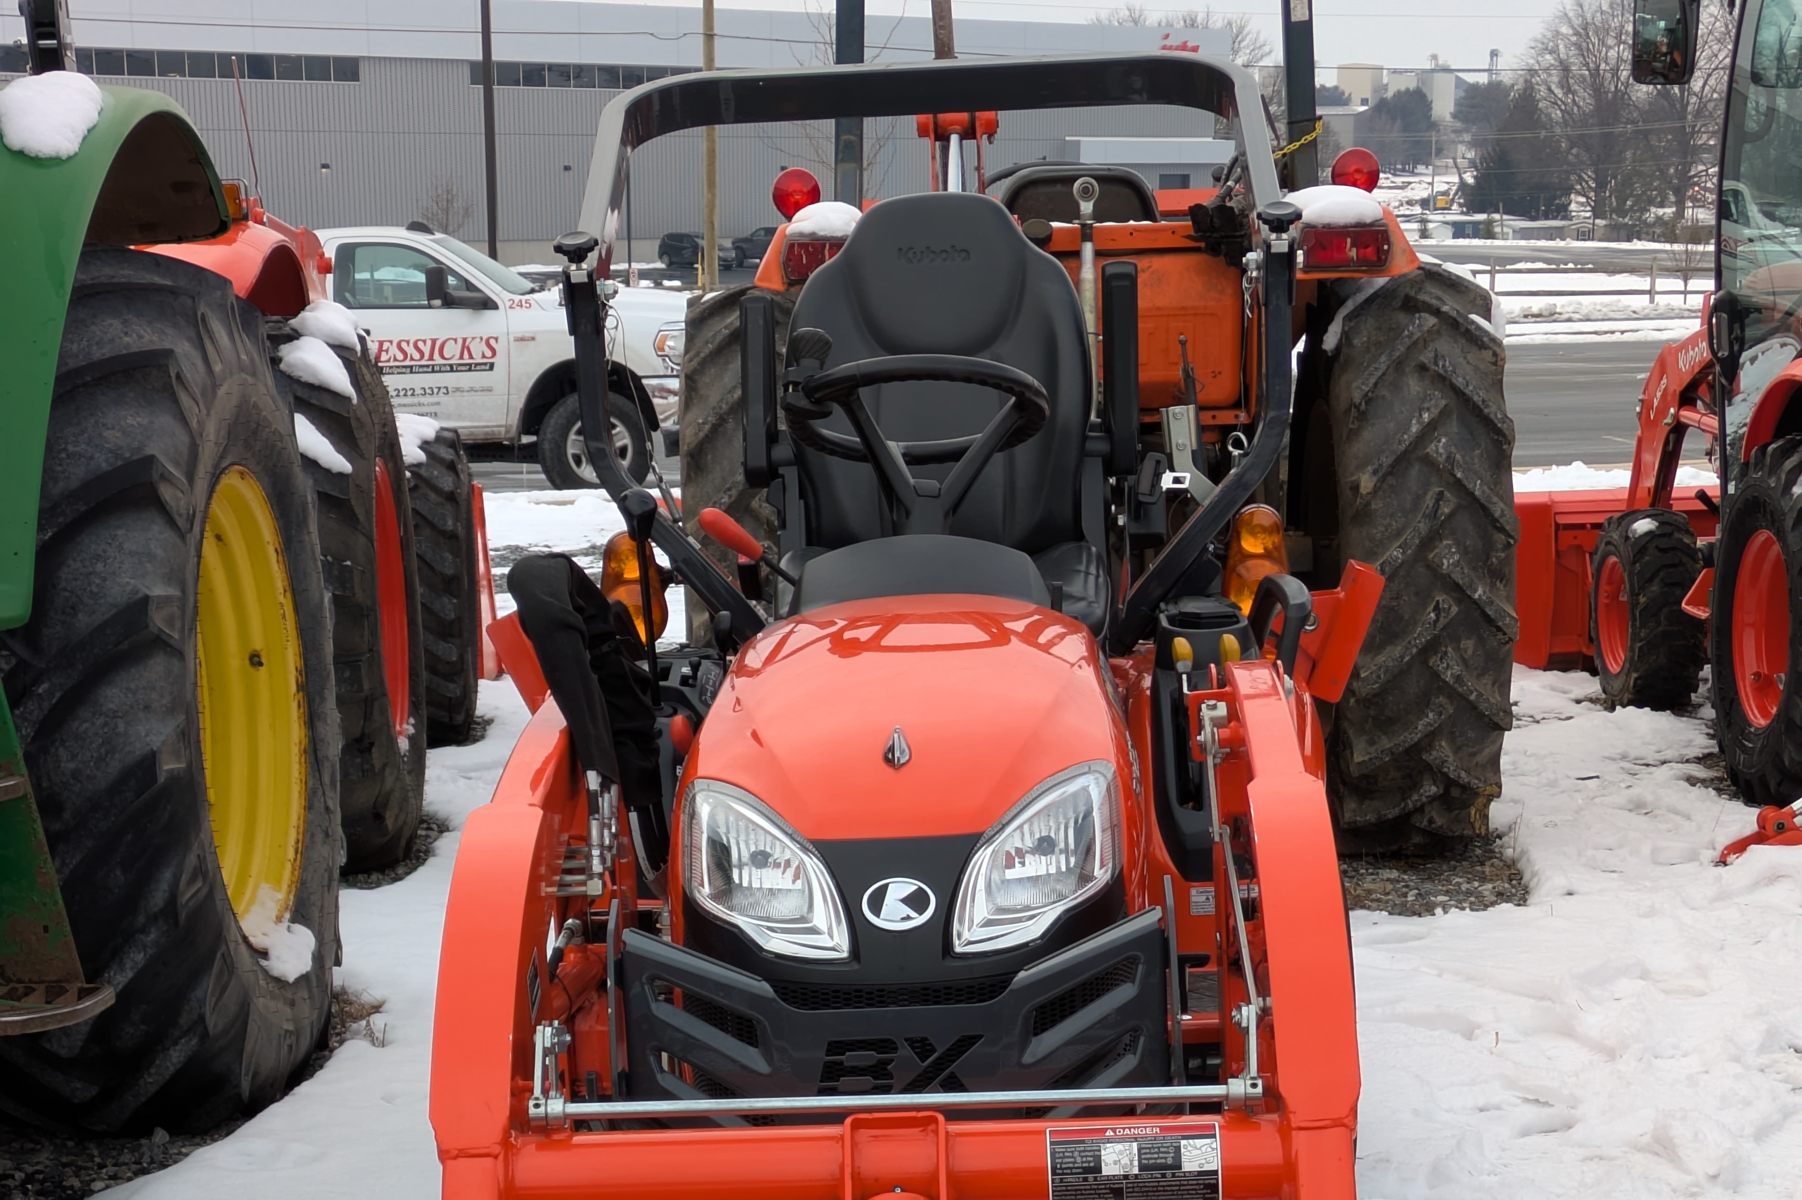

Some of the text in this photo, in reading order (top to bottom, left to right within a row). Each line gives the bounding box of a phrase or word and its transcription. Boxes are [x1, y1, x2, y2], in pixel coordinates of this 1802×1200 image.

[897, 244, 971, 264] Kubota
[508, 298, 532, 309] 245
[372, 336, 499, 364] ESSICK'S
[1678, 337, 1707, 372] Kubota
[382, 366, 410, 374] Helping
[816, 1033, 985, 1096] BX
[1116, 1127, 1160, 1136] DANGER
